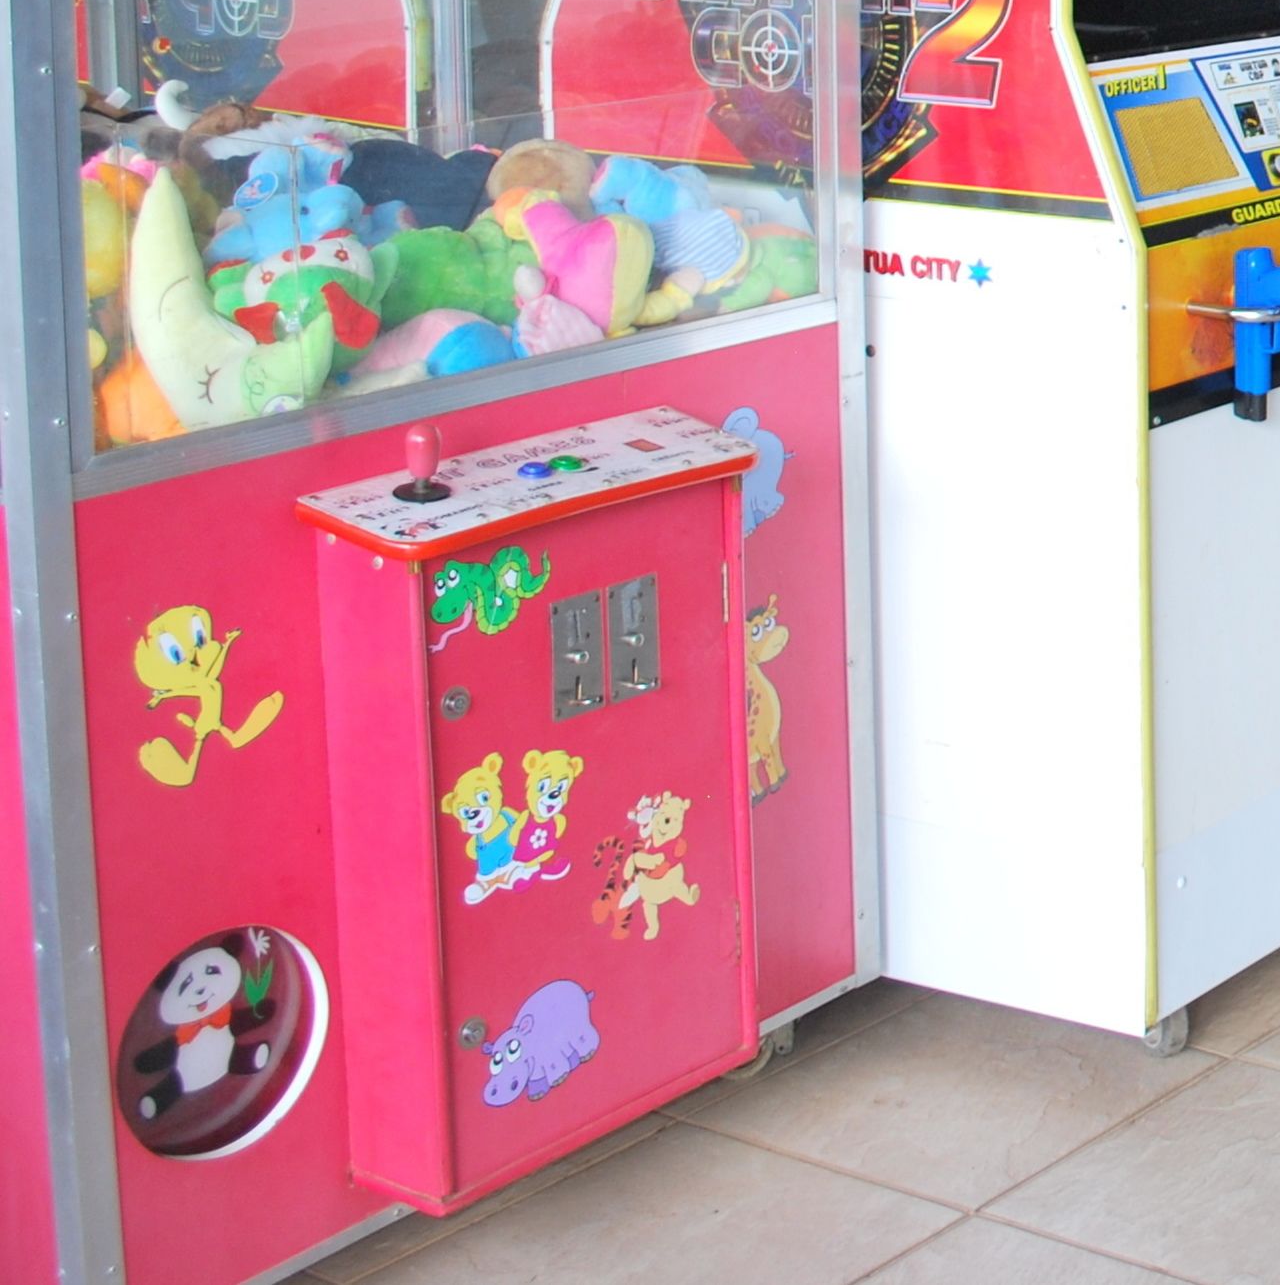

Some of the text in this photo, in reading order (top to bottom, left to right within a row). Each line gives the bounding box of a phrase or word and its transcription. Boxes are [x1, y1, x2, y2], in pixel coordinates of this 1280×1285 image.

[690, 6, 814, 97] CO
[1104, 63, 1167, 99] OFFICER 1
[862, 248, 962, 283] TUA CITY
